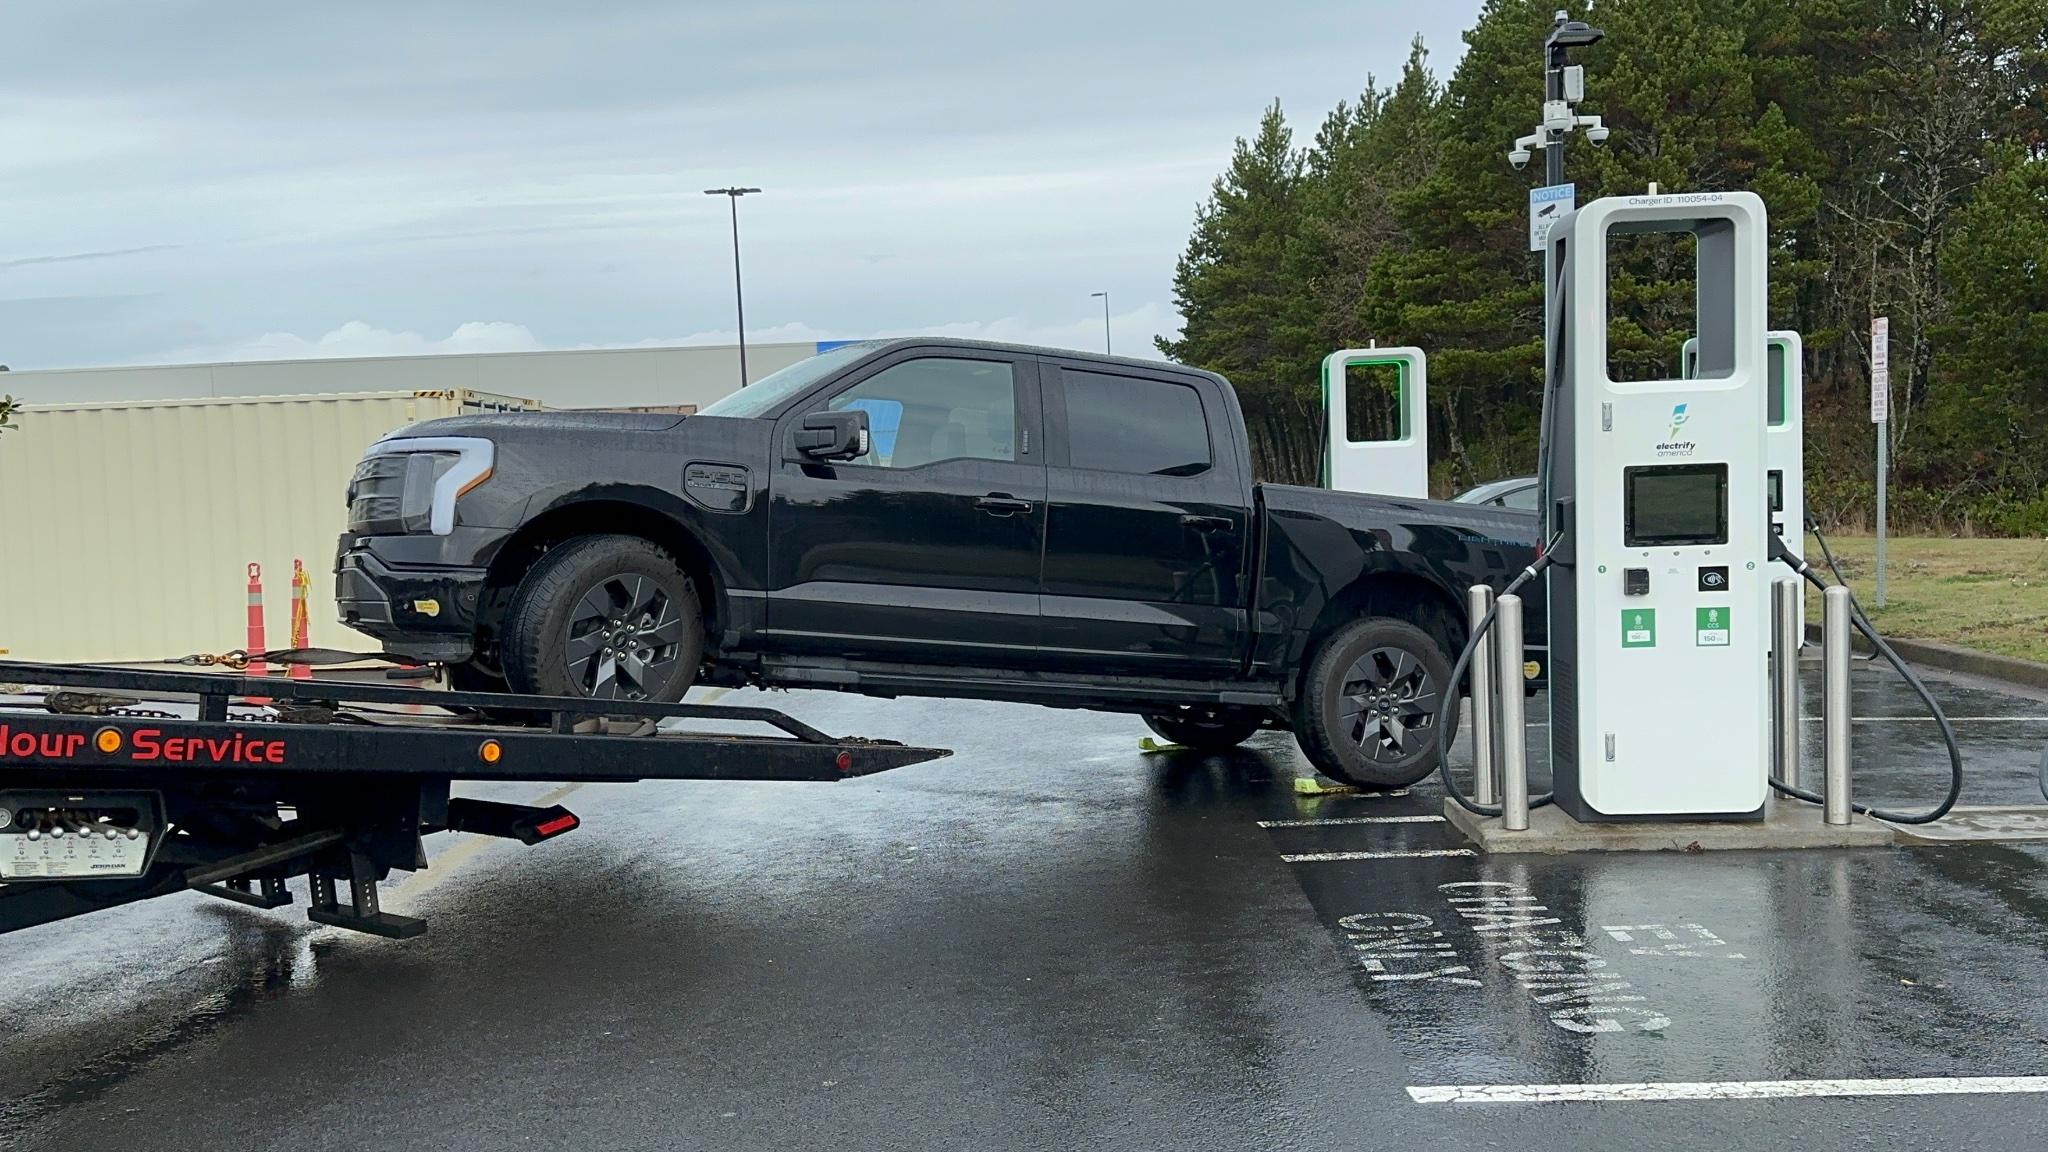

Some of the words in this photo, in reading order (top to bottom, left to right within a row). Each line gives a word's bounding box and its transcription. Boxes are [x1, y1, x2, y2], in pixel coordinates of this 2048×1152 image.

[1533, 187, 1572, 202] NOTICE
[1628, 197, 1662, 206] Charger
[1663, 196, 1673, 204] ID
[1677, 194, 1723, 203] 110054-04
[1656, 441, 1696, 451] electrify
[688, 470, 746, 484] F-150
[132, 729, 285, 763] Service
[1337, 912, 1484, 987] ONLY
[1437, 881, 1672, 1034] CHARGING
